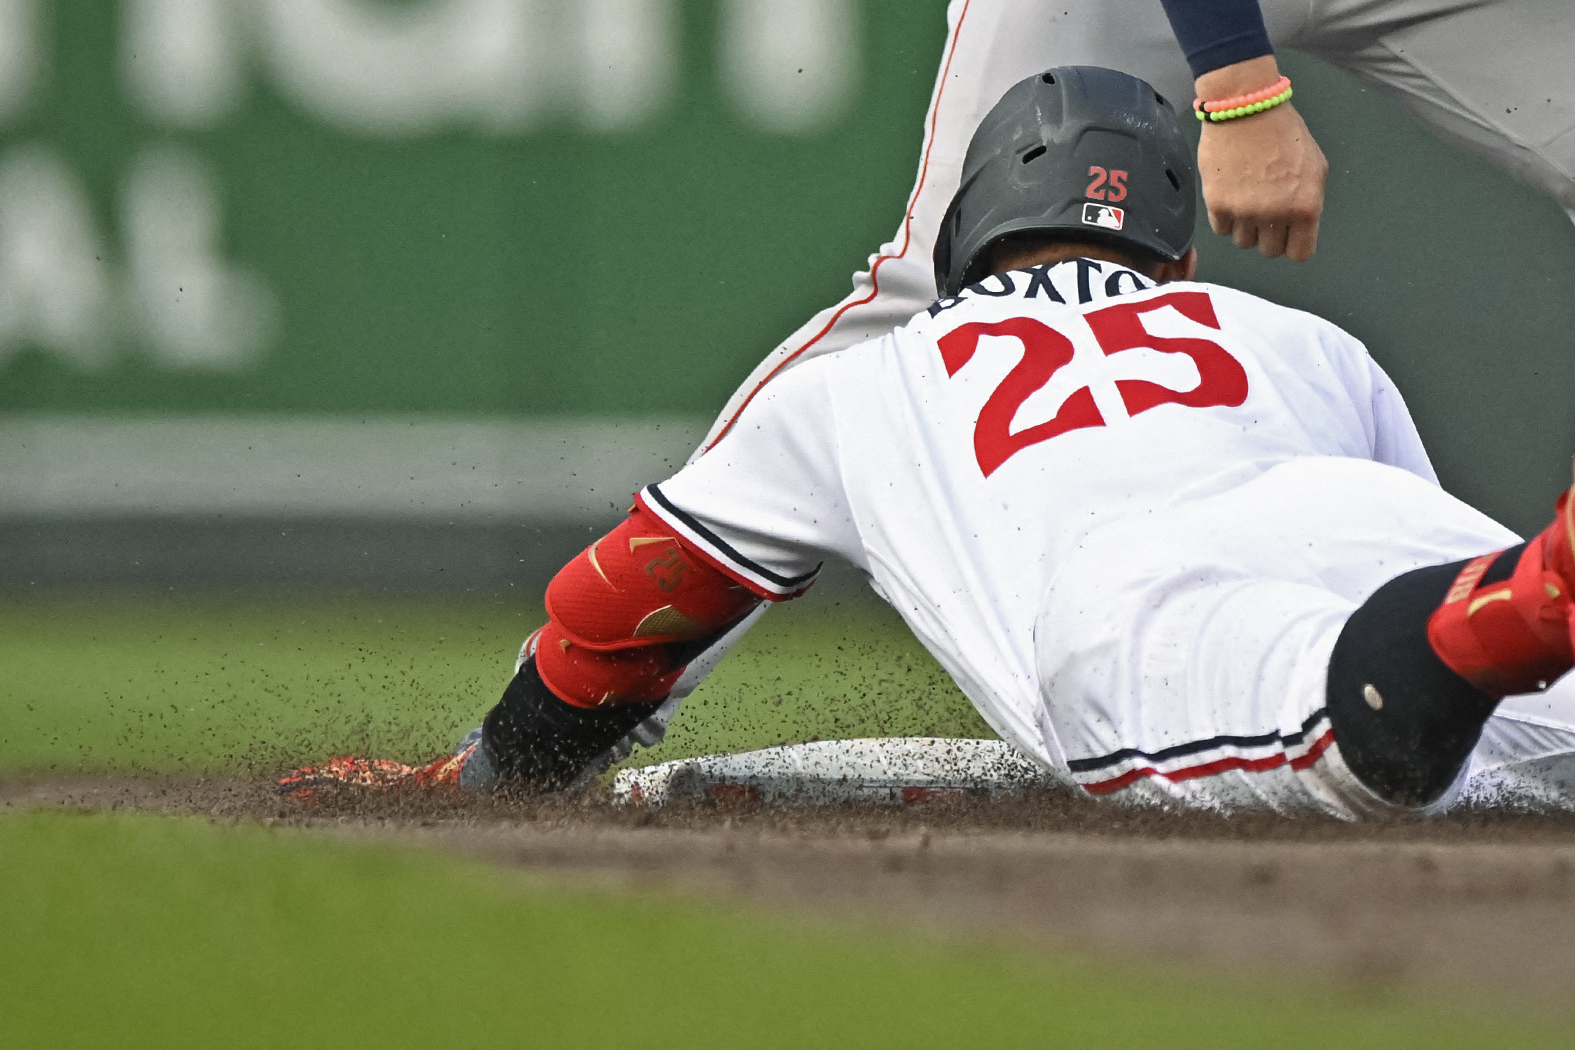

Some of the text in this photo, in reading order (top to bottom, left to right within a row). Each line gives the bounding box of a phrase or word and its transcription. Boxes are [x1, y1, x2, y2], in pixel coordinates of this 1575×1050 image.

[1085, 165, 1129, 203] 25
[937, 291, 1249, 479] 25
[645, 546, 690, 592] 25
